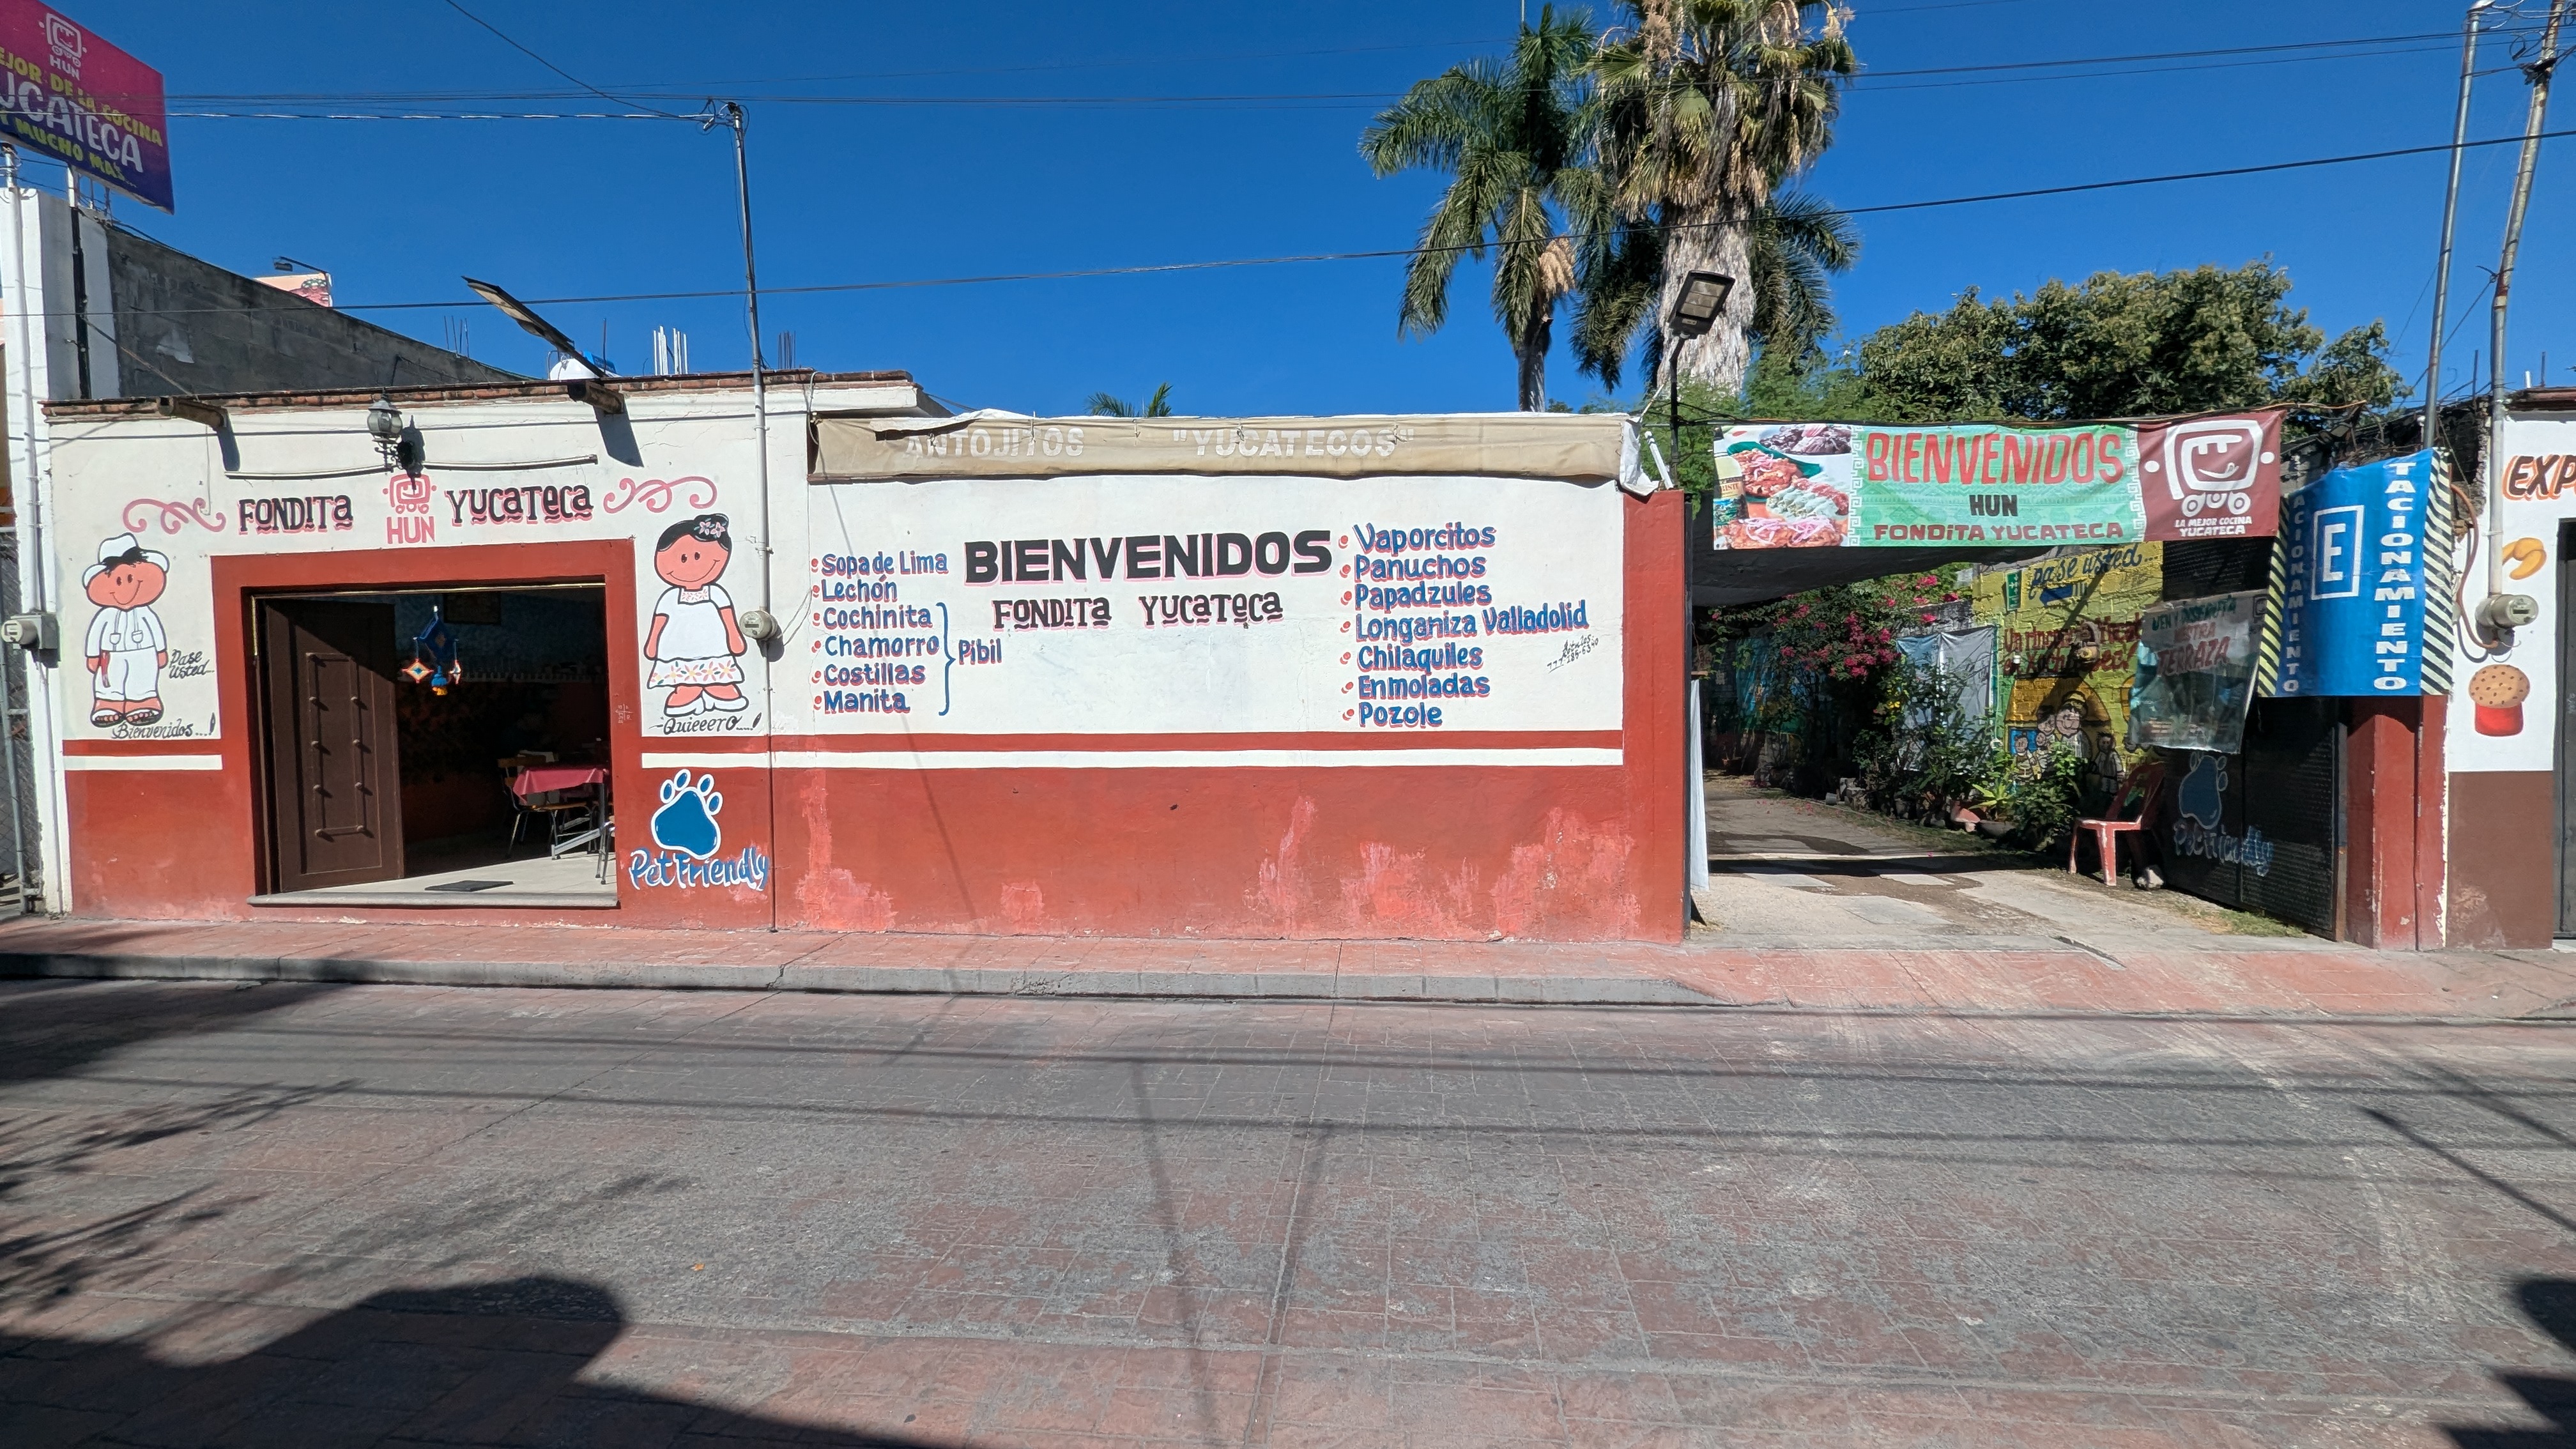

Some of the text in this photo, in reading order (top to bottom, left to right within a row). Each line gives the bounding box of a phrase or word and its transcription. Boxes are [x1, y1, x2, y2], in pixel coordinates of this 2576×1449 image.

[49, 54, 80, 80] HUN
[50, 73, 74, 96] DE
[77, 88, 96, 112] LA
[102, 103, 163, 147] COCINA
[15, 116, 84, 162] MUCHO
[903, 427, 1085, 459] ANTOJITOS
[1867, 433, 2123, 485] BIENVENIDOS
[1970, 494, 2018, 517] HUN
[387, 516, 435, 544] HUN
[1993, 521, 2123, 541] YUCATECA
[2175, 516, 2252, 528] LA MEJOR COCINA
[2179, 525, 2246, 537] YUCATECA
[1353, 523, 1496, 556] Vaporcitos
[2322, 523, 2347, 583] E
[821, 550, 949, 577] Sopa de Lima
[964, 530, 1332, 586] BIENVENIDOS
[1354, 554, 1487, 583] Panuchos
[821, 574, 898, 602] Lechón
[2028, 557, 2078, 601] pase
[1354, 581, 1492, 613] Papadzules
[823, 605, 933, 630] Cochinita
[1355, 599, 1589, 645] Longaniza Valladolid
[169, 649, 203, 668] Pase
[825, 634, 940, 659] Chamorro
[958, 638, 1002, 665] Pibil
[1357, 641, 1483, 675] Chilaquiles
[2156, 636, 2230, 675] TERRAZA
[824, 663, 926, 686] Costillas
[1358, 673, 1491, 701] Enmoladas
[824, 689, 911, 714] Manita
[1359, 702, 1443, 728] Pozole
